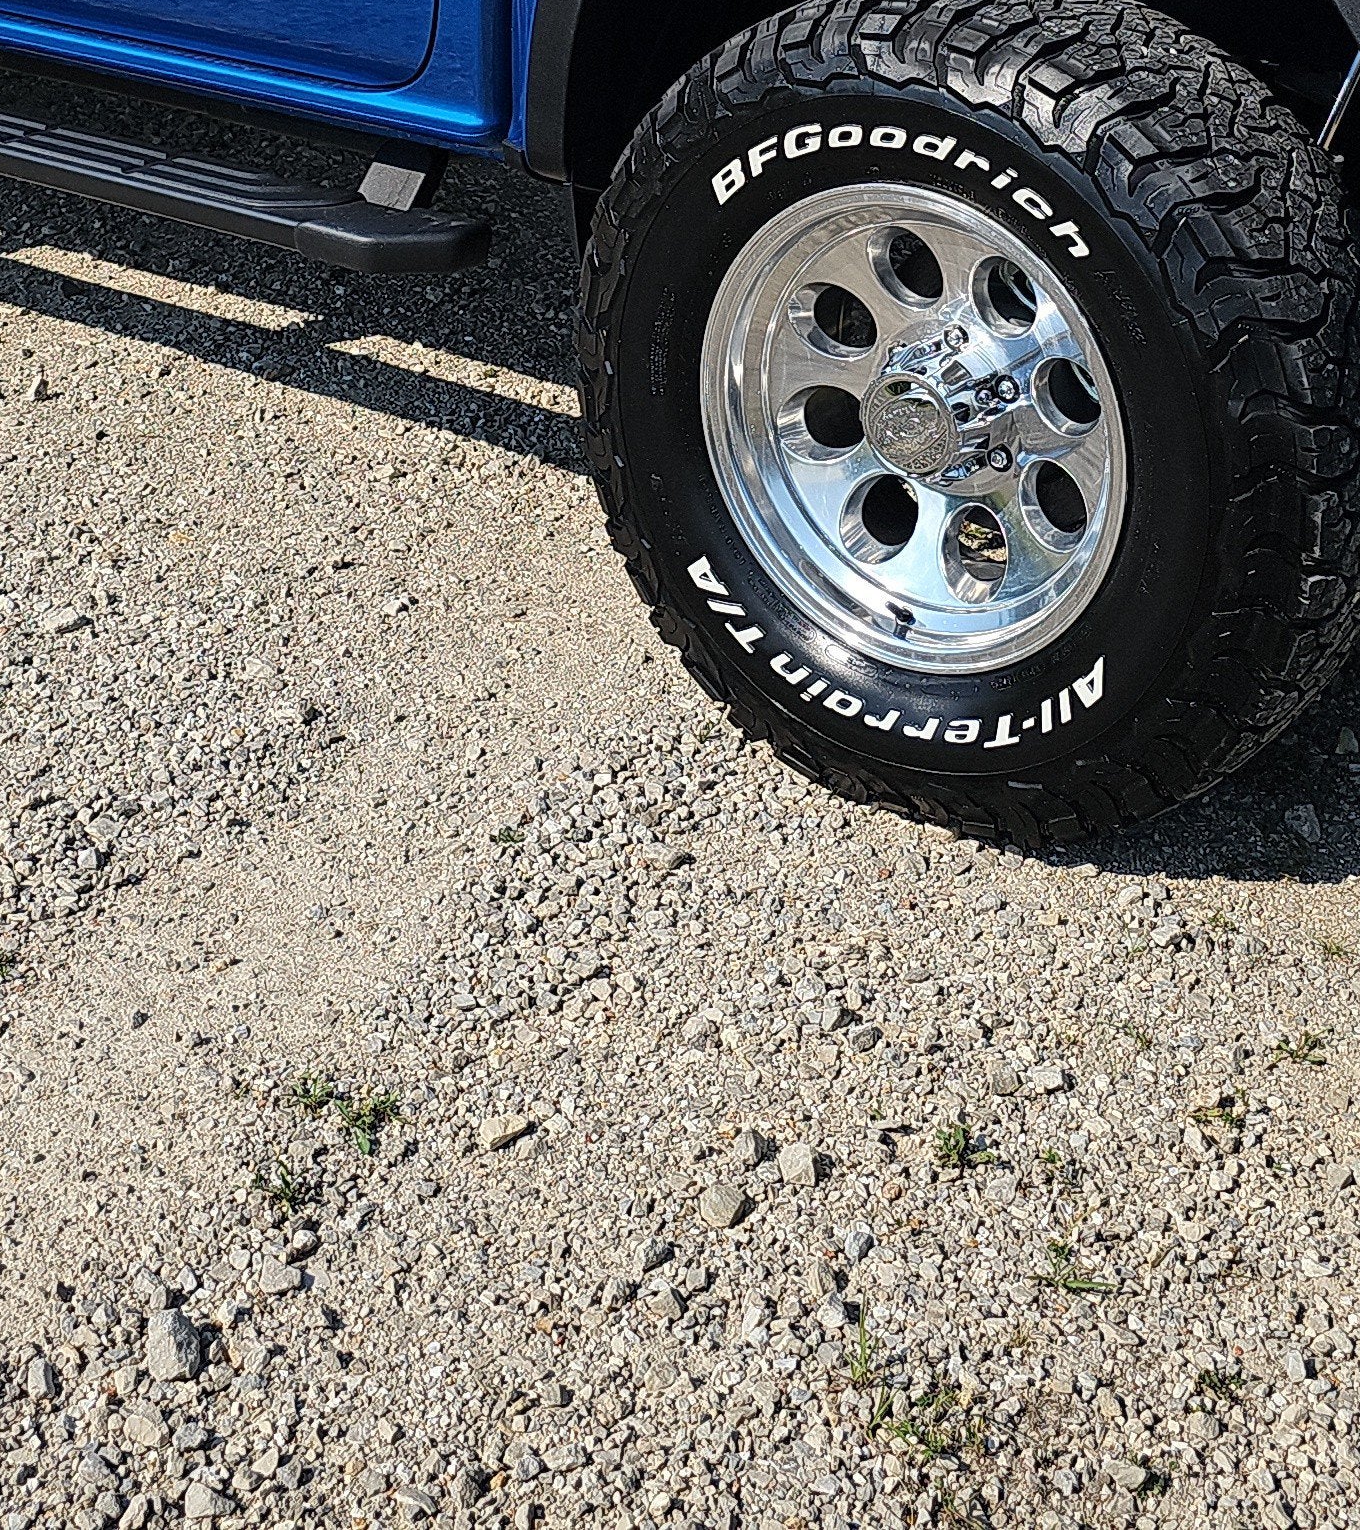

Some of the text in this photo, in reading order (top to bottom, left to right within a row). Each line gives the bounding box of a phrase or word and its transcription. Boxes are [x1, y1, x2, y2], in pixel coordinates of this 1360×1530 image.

[710, 121, 1092, 259] BFGoodrich
[685, 554, 765, 655] T/A
[769, 653, 1106, 749] All-Terrain
